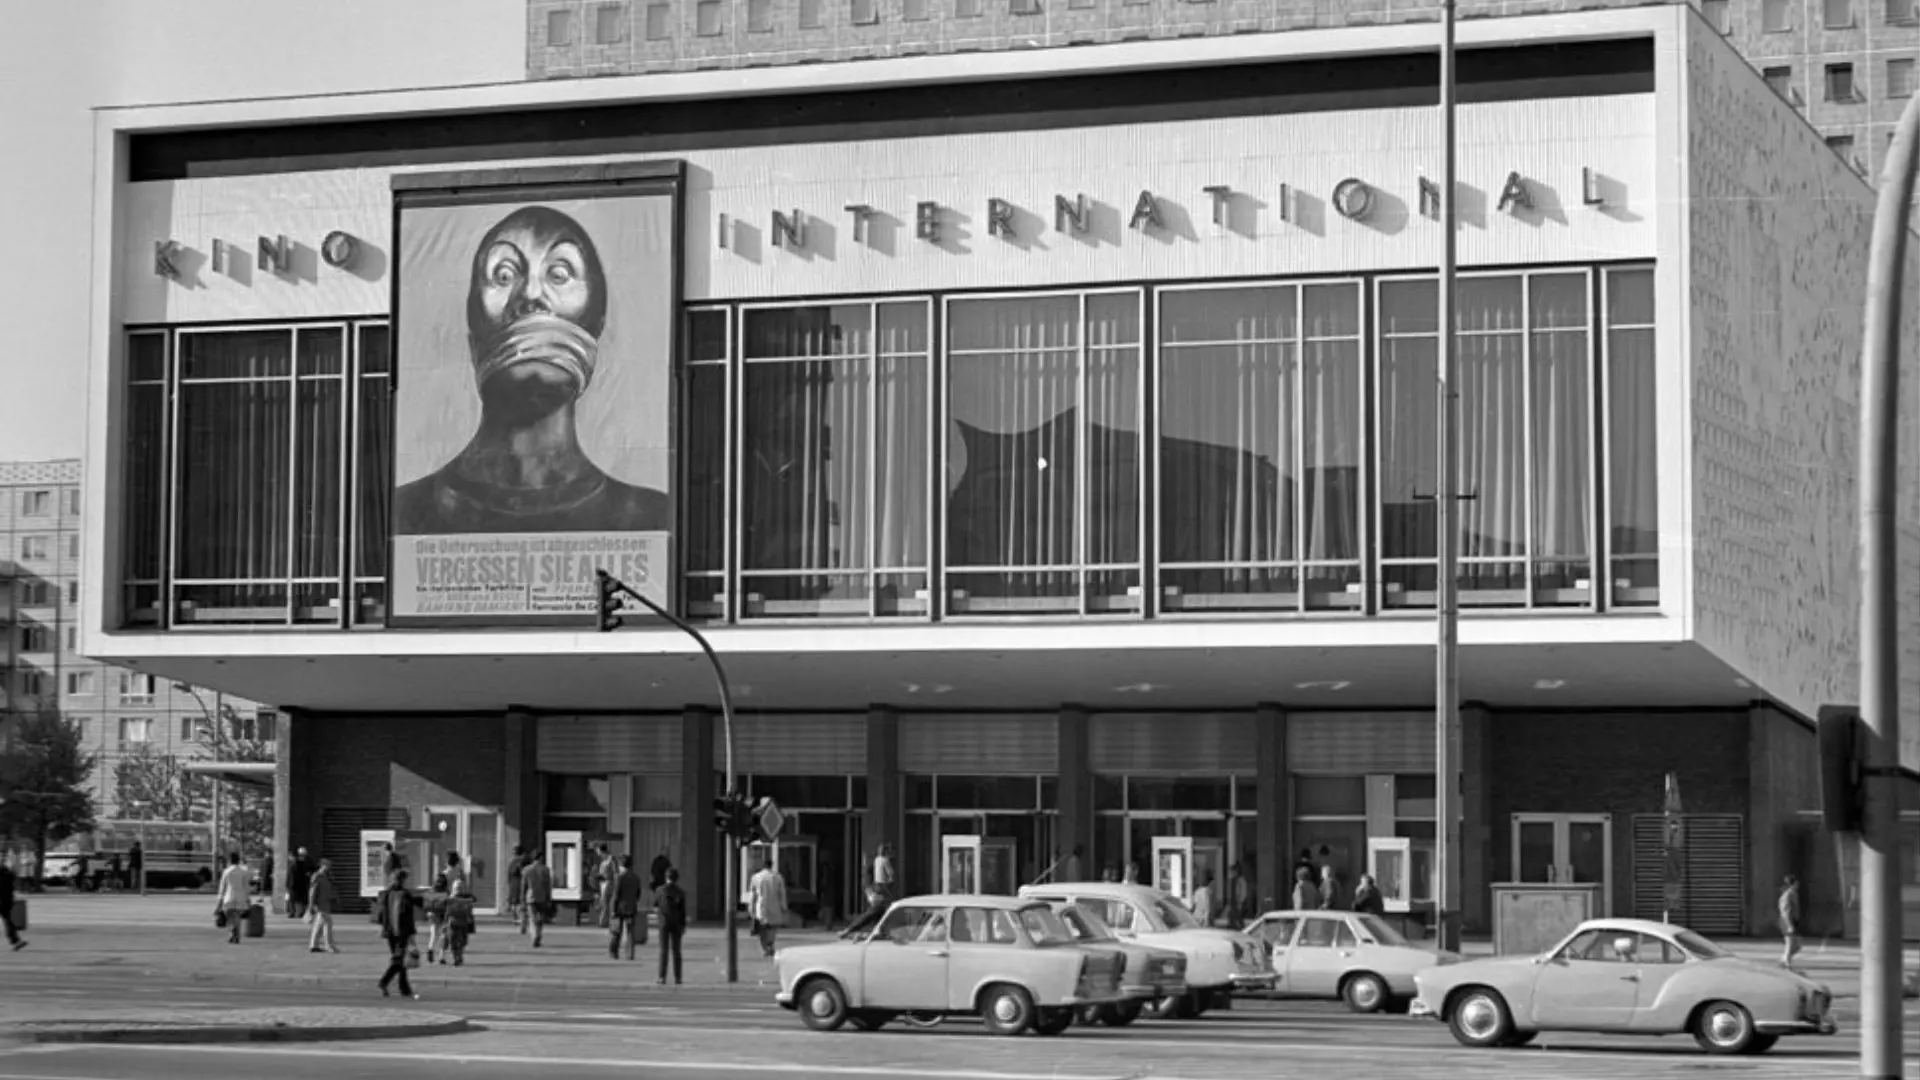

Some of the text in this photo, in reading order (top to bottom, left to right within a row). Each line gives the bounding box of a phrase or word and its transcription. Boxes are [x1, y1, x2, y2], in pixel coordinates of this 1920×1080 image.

[154, 166, 1605, 279] KINO INTERNATIONAL
[416, 540, 436, 554] Die
[416, 554, 535, 583] VERGESSEN
[540, 553, 573, 583] SIE
